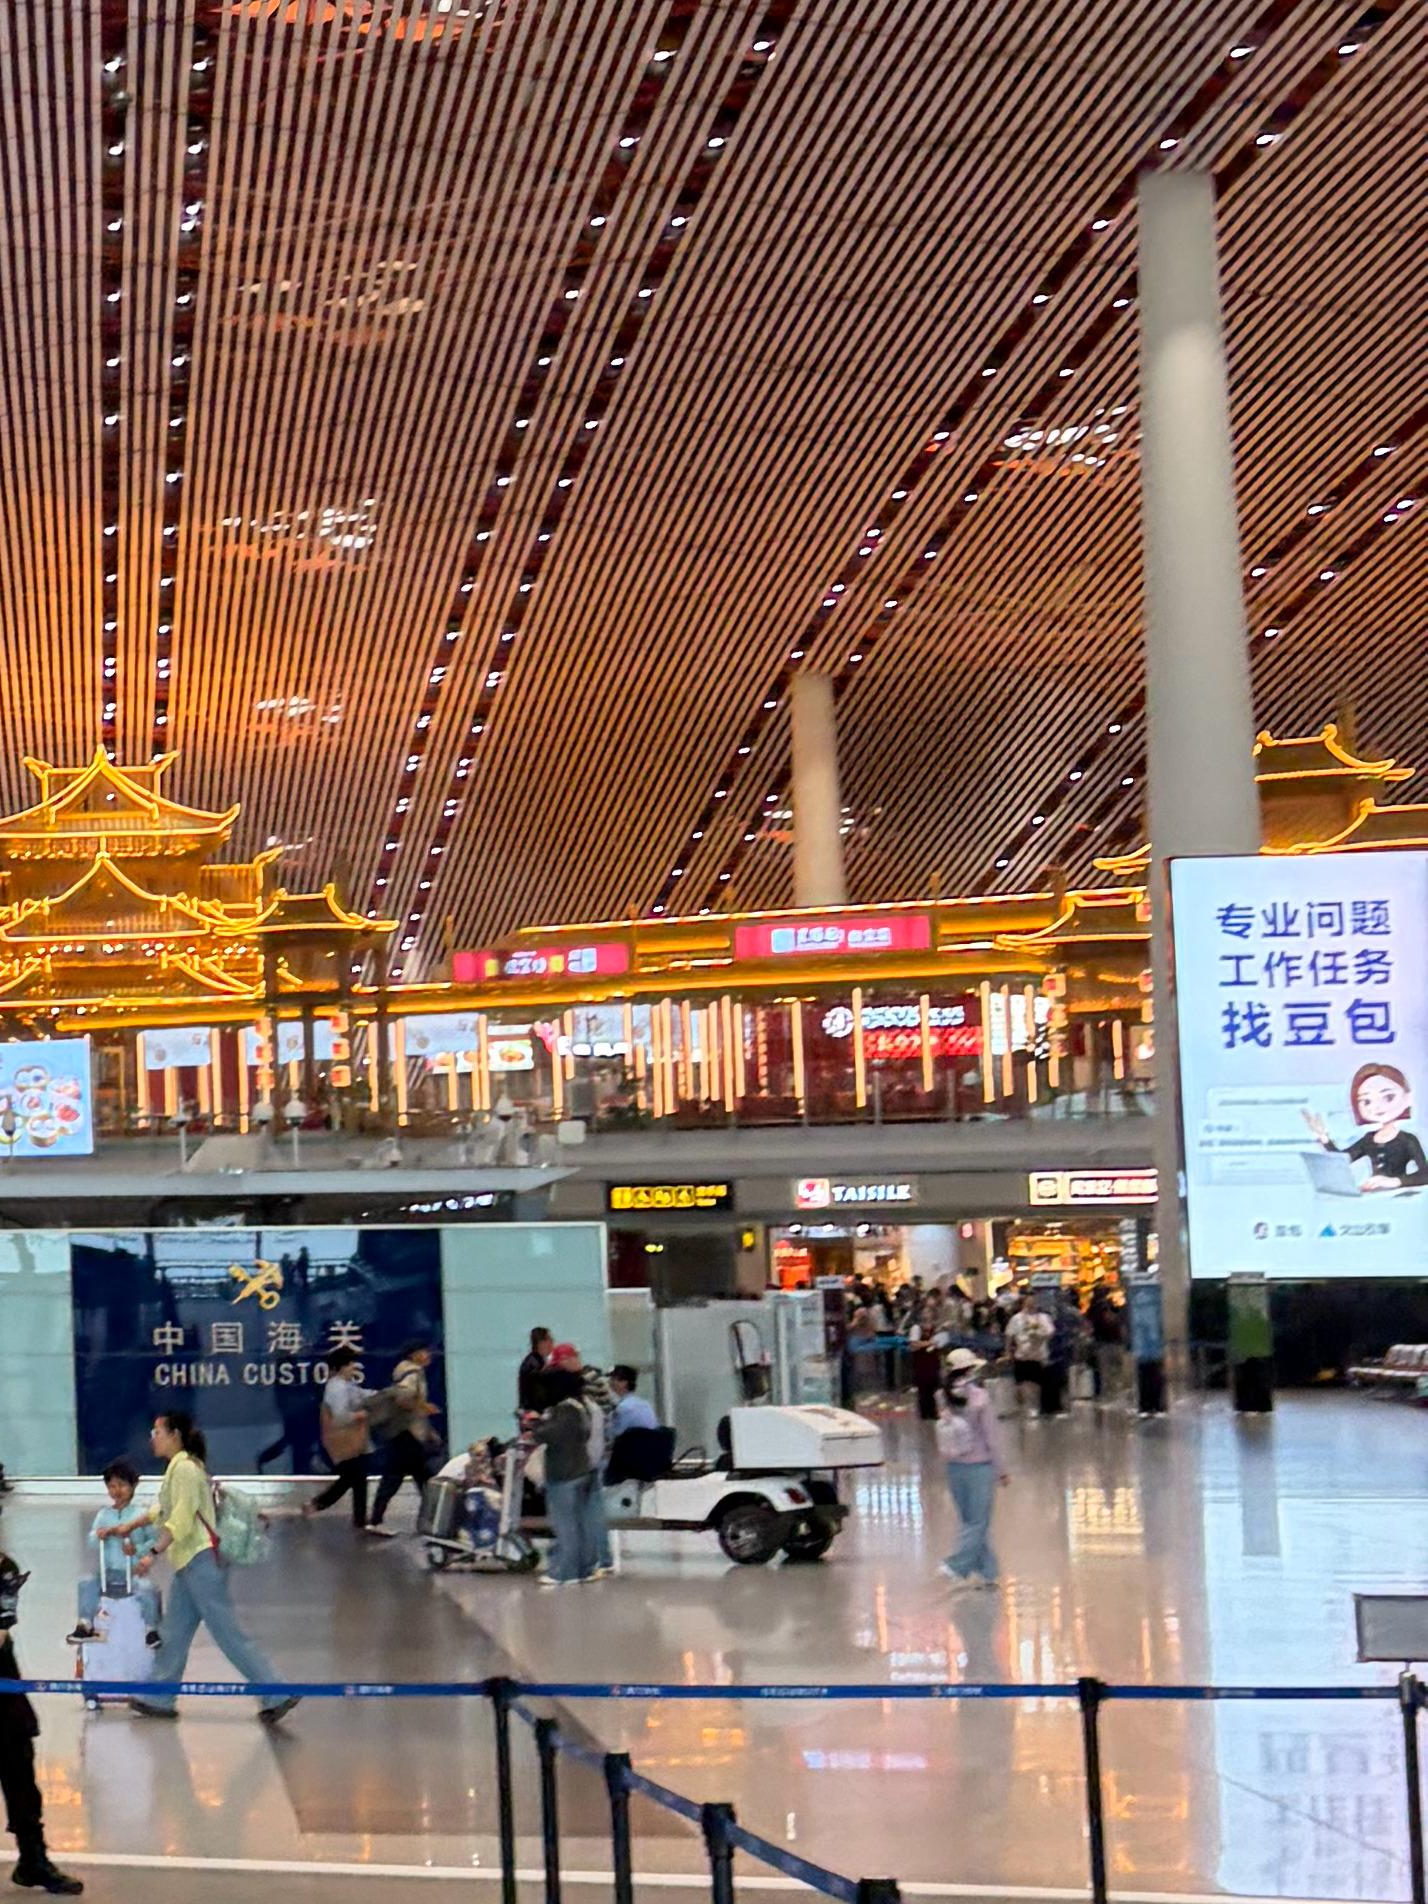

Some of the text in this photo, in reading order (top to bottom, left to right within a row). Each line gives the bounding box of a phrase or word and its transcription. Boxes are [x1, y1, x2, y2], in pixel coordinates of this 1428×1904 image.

[1216, 900, 1392, 939] 专业问题
[1219, 948, 1393, 988] 工作任务
[1221, 999, 1397, 1049] 找豆包
[152, 1320, 365, 1356] 中国海关
[155, 1362, 366, 1386] CHINA CUSTOS
